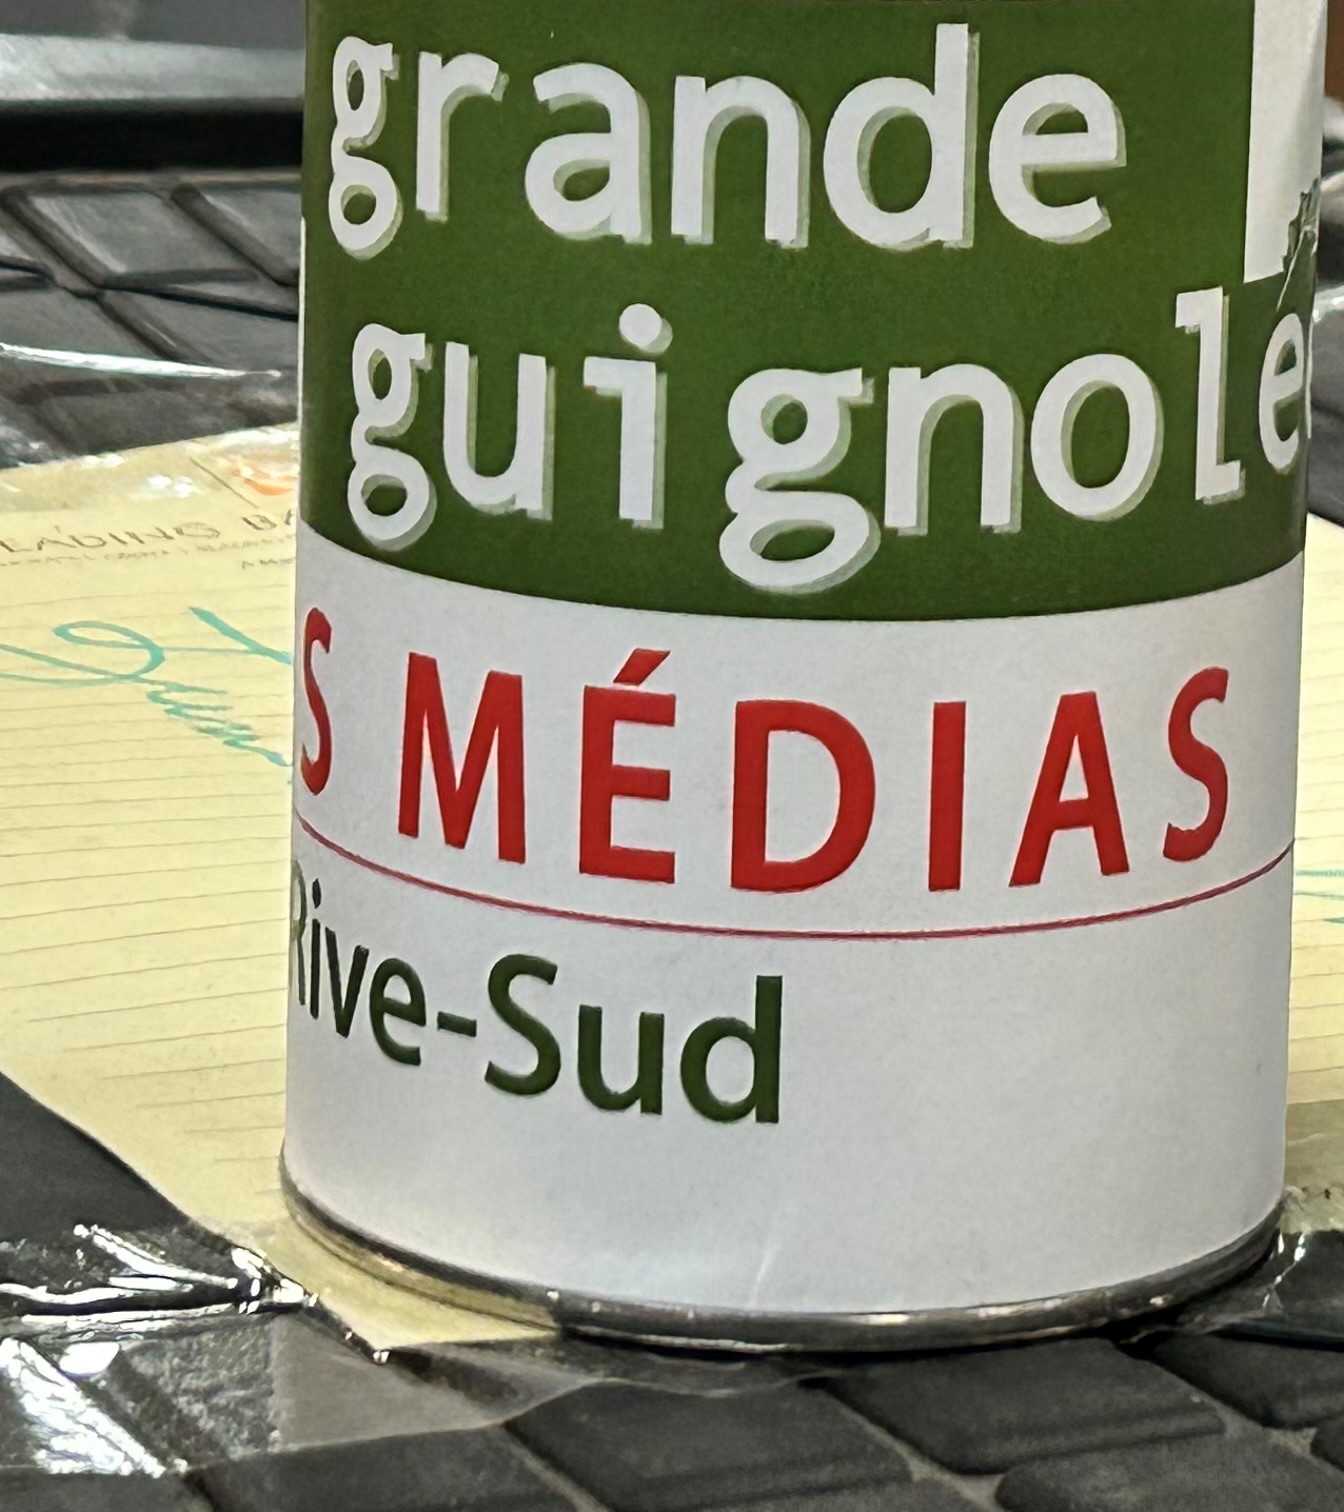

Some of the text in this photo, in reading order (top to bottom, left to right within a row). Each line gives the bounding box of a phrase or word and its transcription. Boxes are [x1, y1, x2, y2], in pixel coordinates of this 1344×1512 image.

[328, 22, 1126, 259] grande
[346, 285, 1312, 595] guignolé
[397, 647, 1229, 893] MÉDIAS
